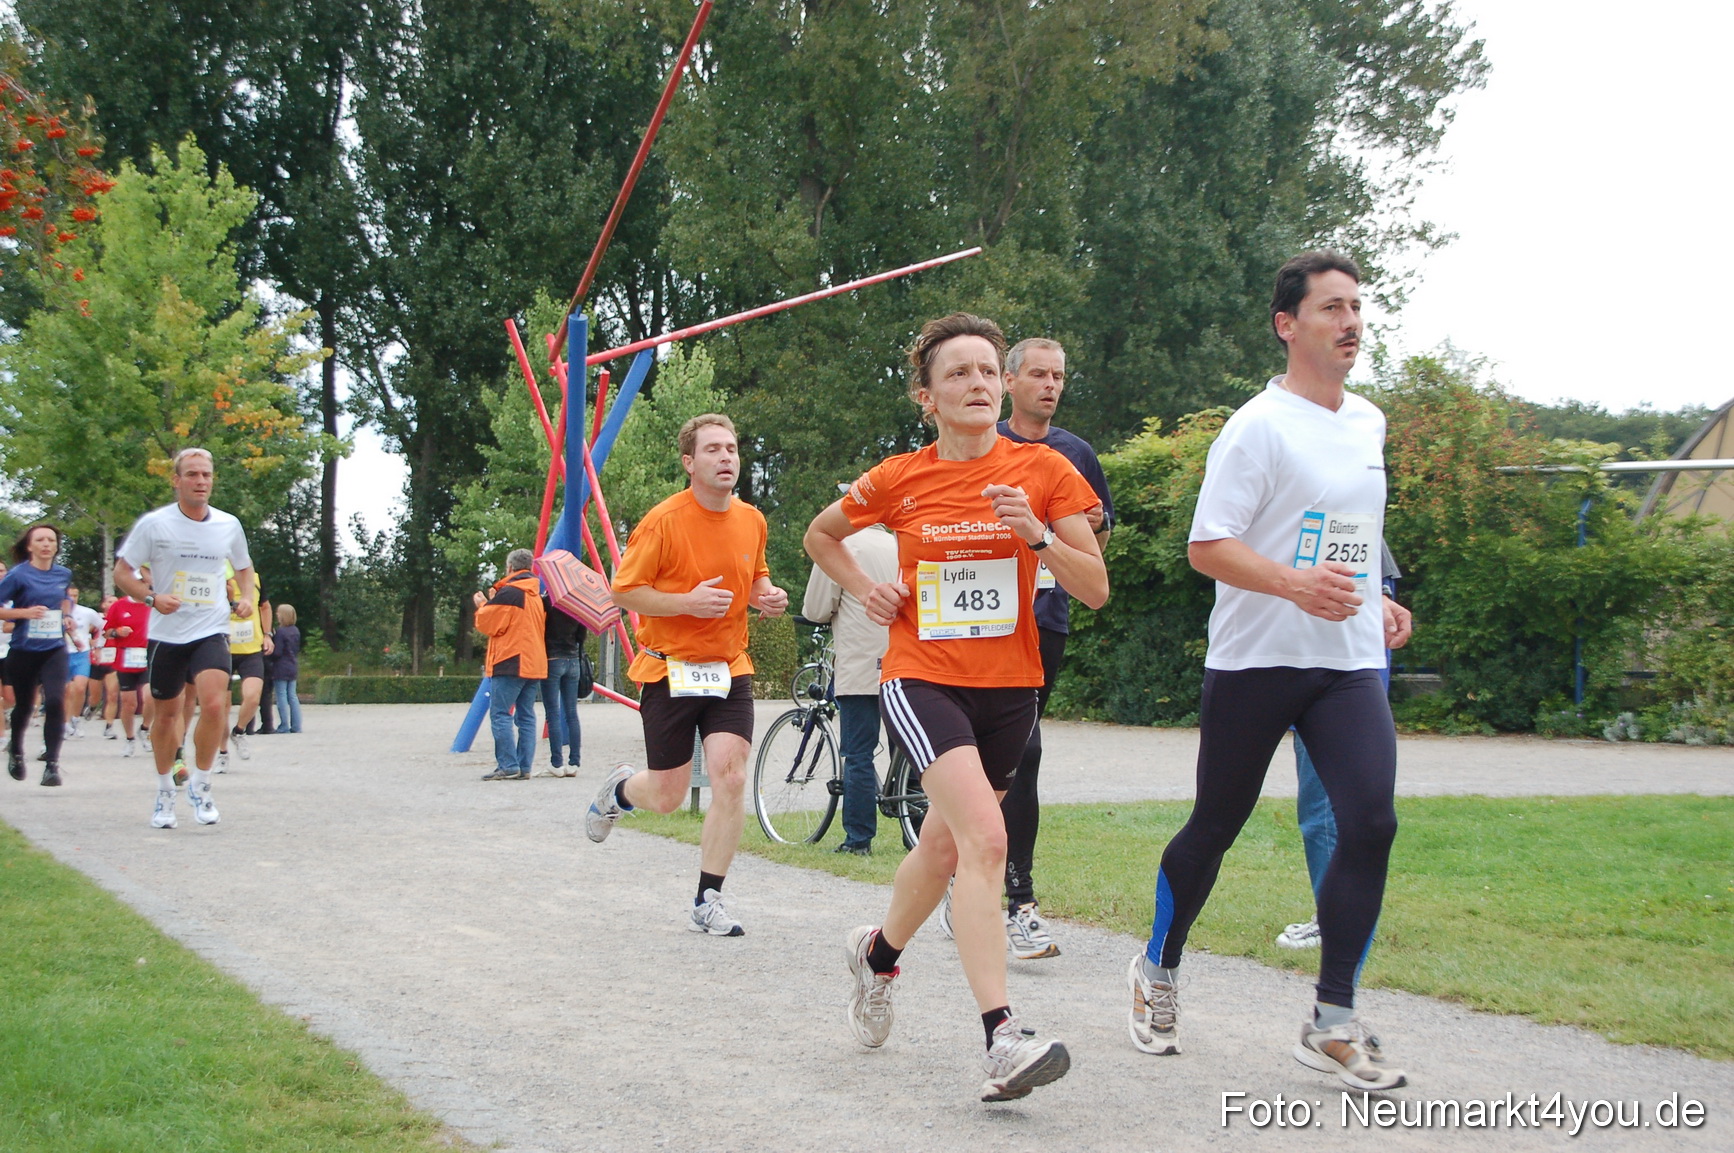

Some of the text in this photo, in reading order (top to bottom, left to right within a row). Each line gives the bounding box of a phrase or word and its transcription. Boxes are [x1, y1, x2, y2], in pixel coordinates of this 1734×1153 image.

[1329, 519, 1359, 535] Günter
[934, 534, 967, 543] Nürnberger
[968, 532, 995, 541] Stadtlauf
[1305, 538, 1312, 548] C
[1325, 542, 1369, 563] 2525
[943, 567, 977, 584] Lydia
[190, 585, 211, 597] 619
[922, 590, 928, 602] B
[953, 588, 1001, 612] 483
[980, 623, 1016, 632] PFLEIDERER
[691, 671, 721, 682] 918
